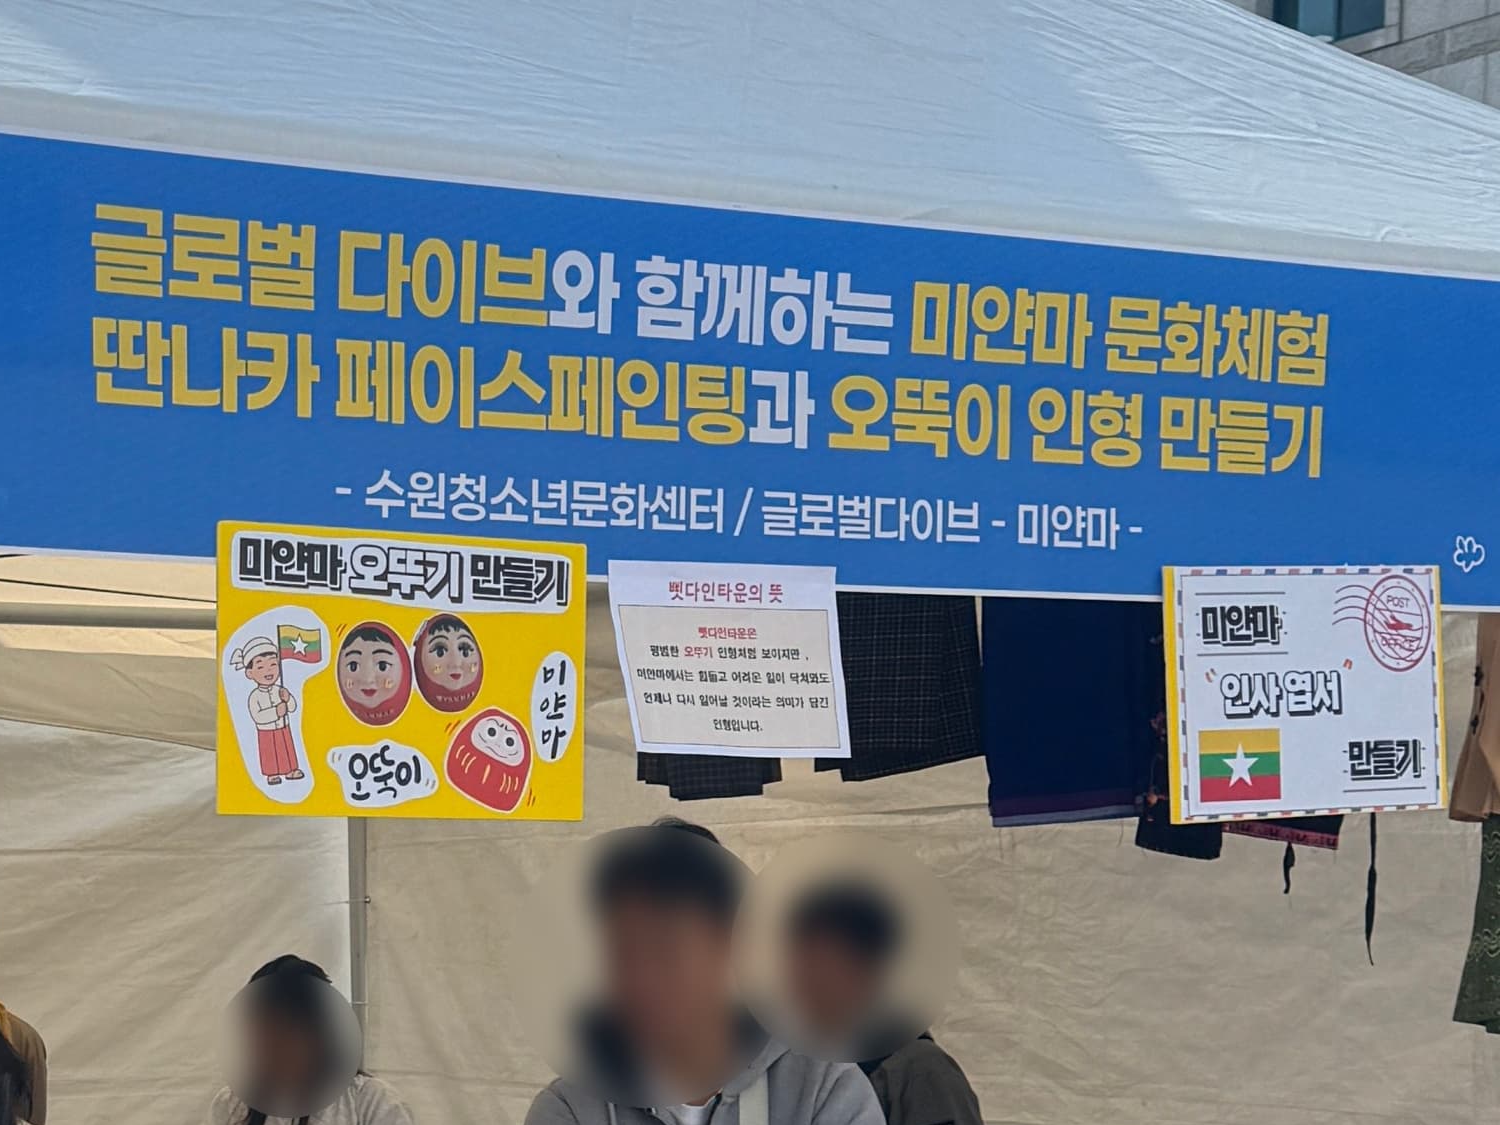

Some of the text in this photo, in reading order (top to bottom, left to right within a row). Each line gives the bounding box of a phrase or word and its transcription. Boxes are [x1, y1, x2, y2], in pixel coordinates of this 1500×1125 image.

[92, 203, 1330, 387] 글로벌 다이브와 함께하는 미얀마 문화체험
[92, 316, 1324, 479] 딴나카 페이스페인팅과 오뚝이 인형 만들기
[364, 468, 724, 534] 수원청소년문화센터
[732, 486, 754, 536] /
[761, 489, 981, 544] 글로벌다이브
[1017, 503, 1120, 551] 미얀마
[239, 536, 570, 607] 미얀마 오뚜기 만들기
[768, 583, 784, 604] 뜻
[1386, 594, 1410, 608] POST
[1200, 604, 1283, 647] 미얀마
[649, 644, 680, 658] 평범한
[684, 645, 713, 659] 오뚜기
[717, 646, 757, 660] 인형처럼
[636, 667, 831, 684] 미얀마에서는 힘들고 어려운 일이 닥쳐와도
[1219, 669, 1343, 719] 인사 엽서
[539, 659, 567, 760] 미얀마
[643, 691, 829, 709] 언제나 다시 일어날 것이라는 의미가 담긴
[349, 744, 422, 801] 오뚝이
[1348, 738, 1421, 781] 만들기
